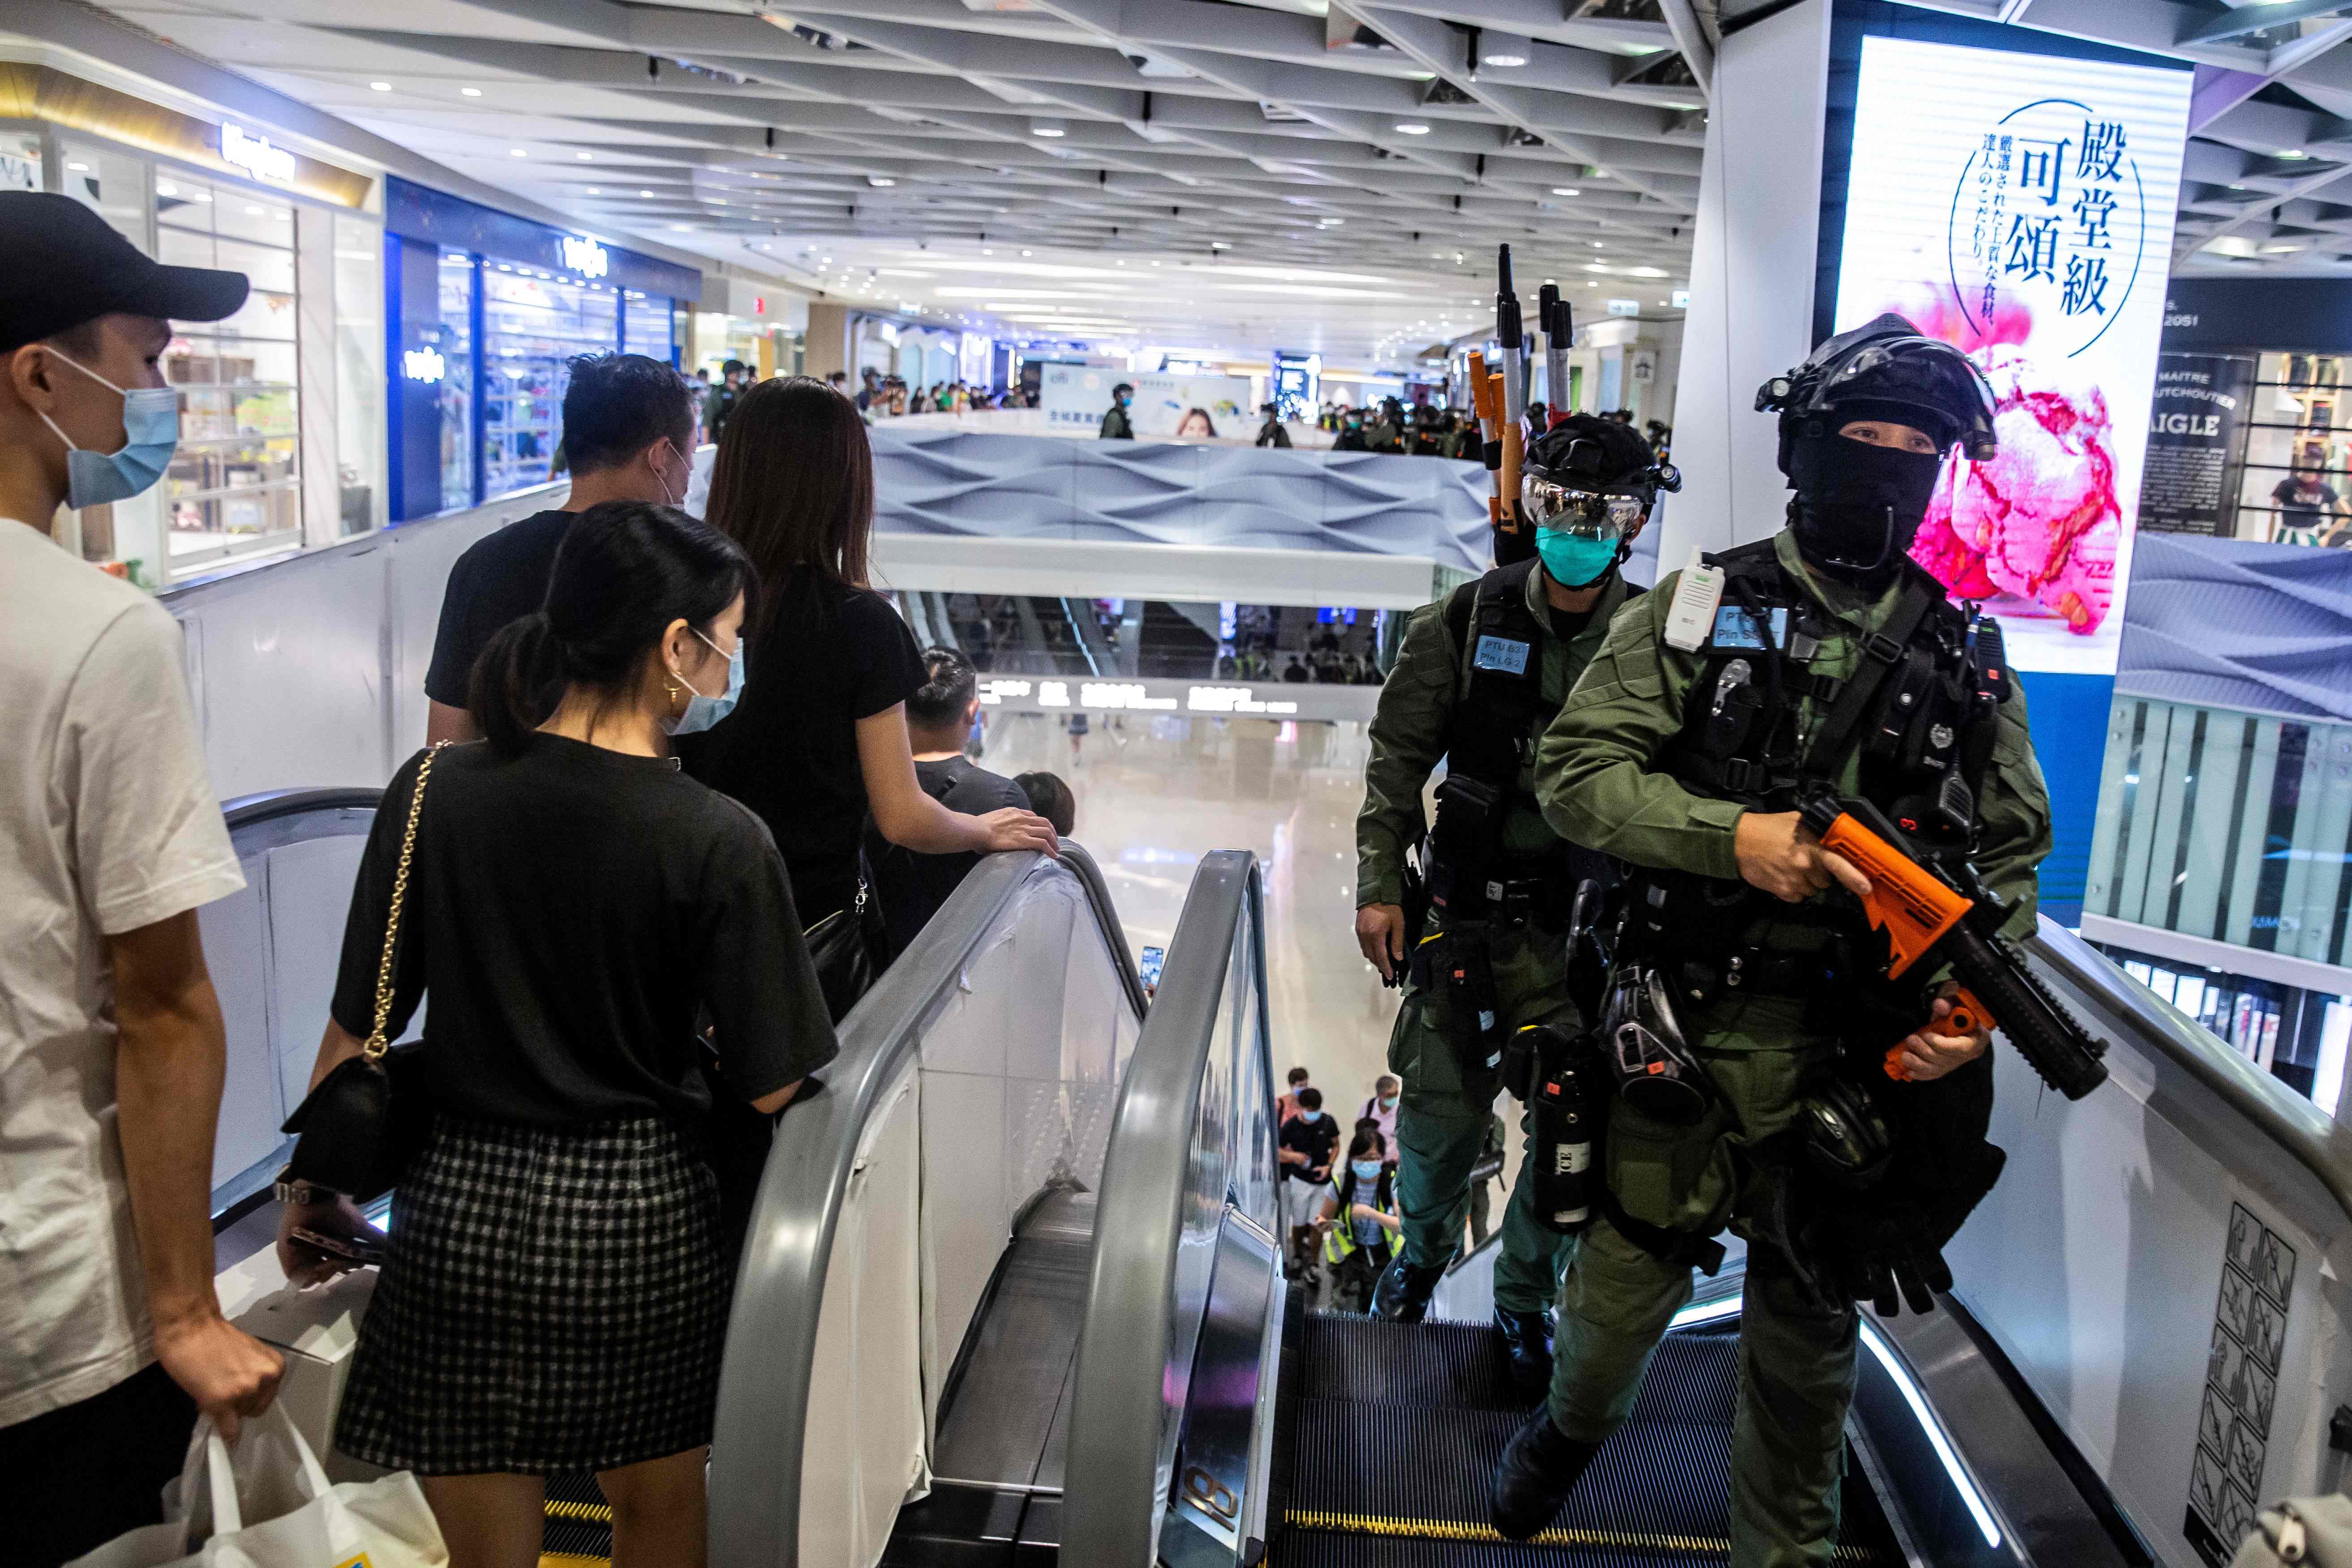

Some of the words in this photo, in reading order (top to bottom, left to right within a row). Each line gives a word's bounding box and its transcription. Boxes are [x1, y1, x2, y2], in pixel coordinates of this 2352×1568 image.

[2004, 136, 2072, 285] 可頌
[2060, 119, 2127, 316] 殿堂級
